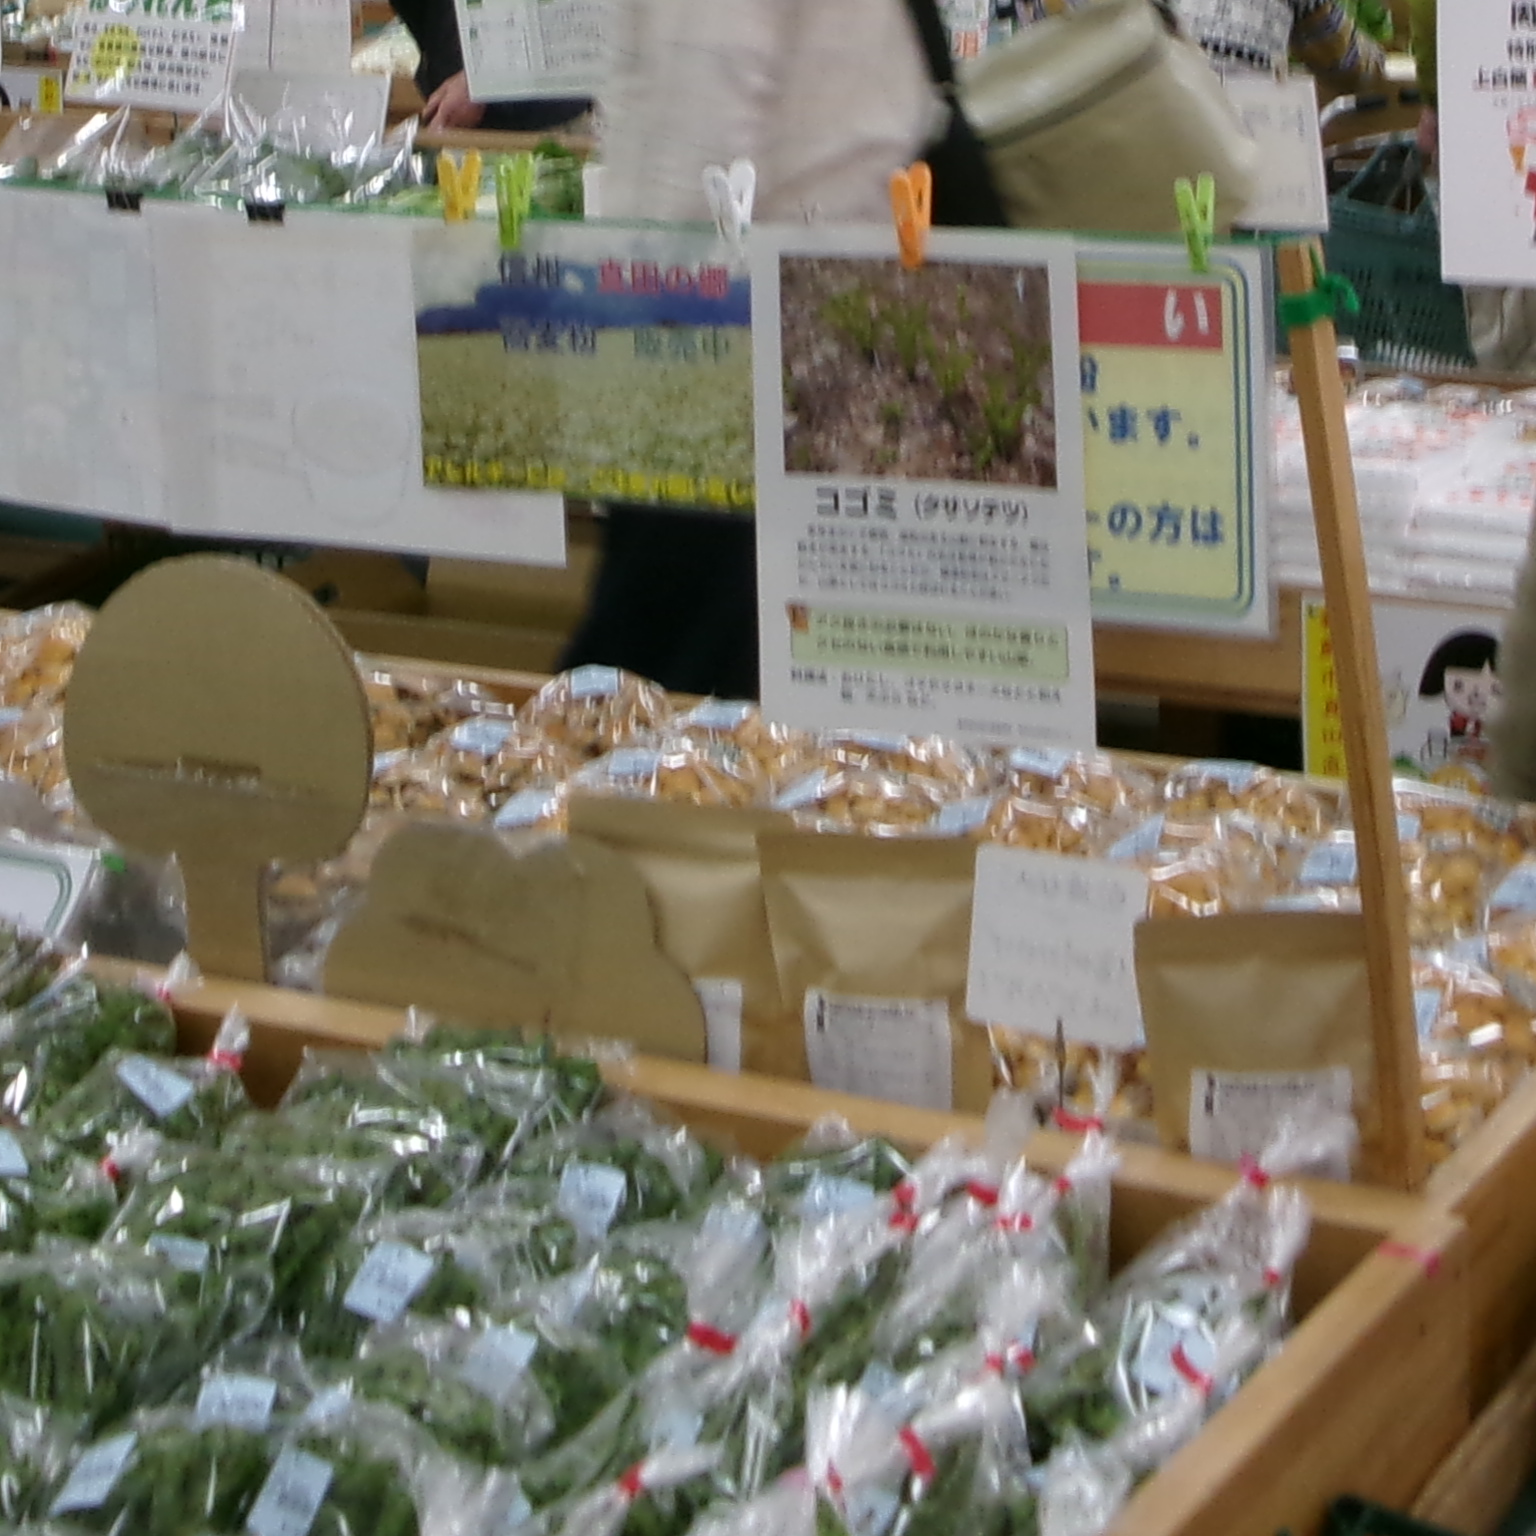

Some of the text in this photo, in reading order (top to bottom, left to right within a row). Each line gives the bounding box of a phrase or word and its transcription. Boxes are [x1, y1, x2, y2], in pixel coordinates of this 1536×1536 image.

[816, 486, 897, 520] コゴミ
[1085, 499, 1224, 548] の方は
